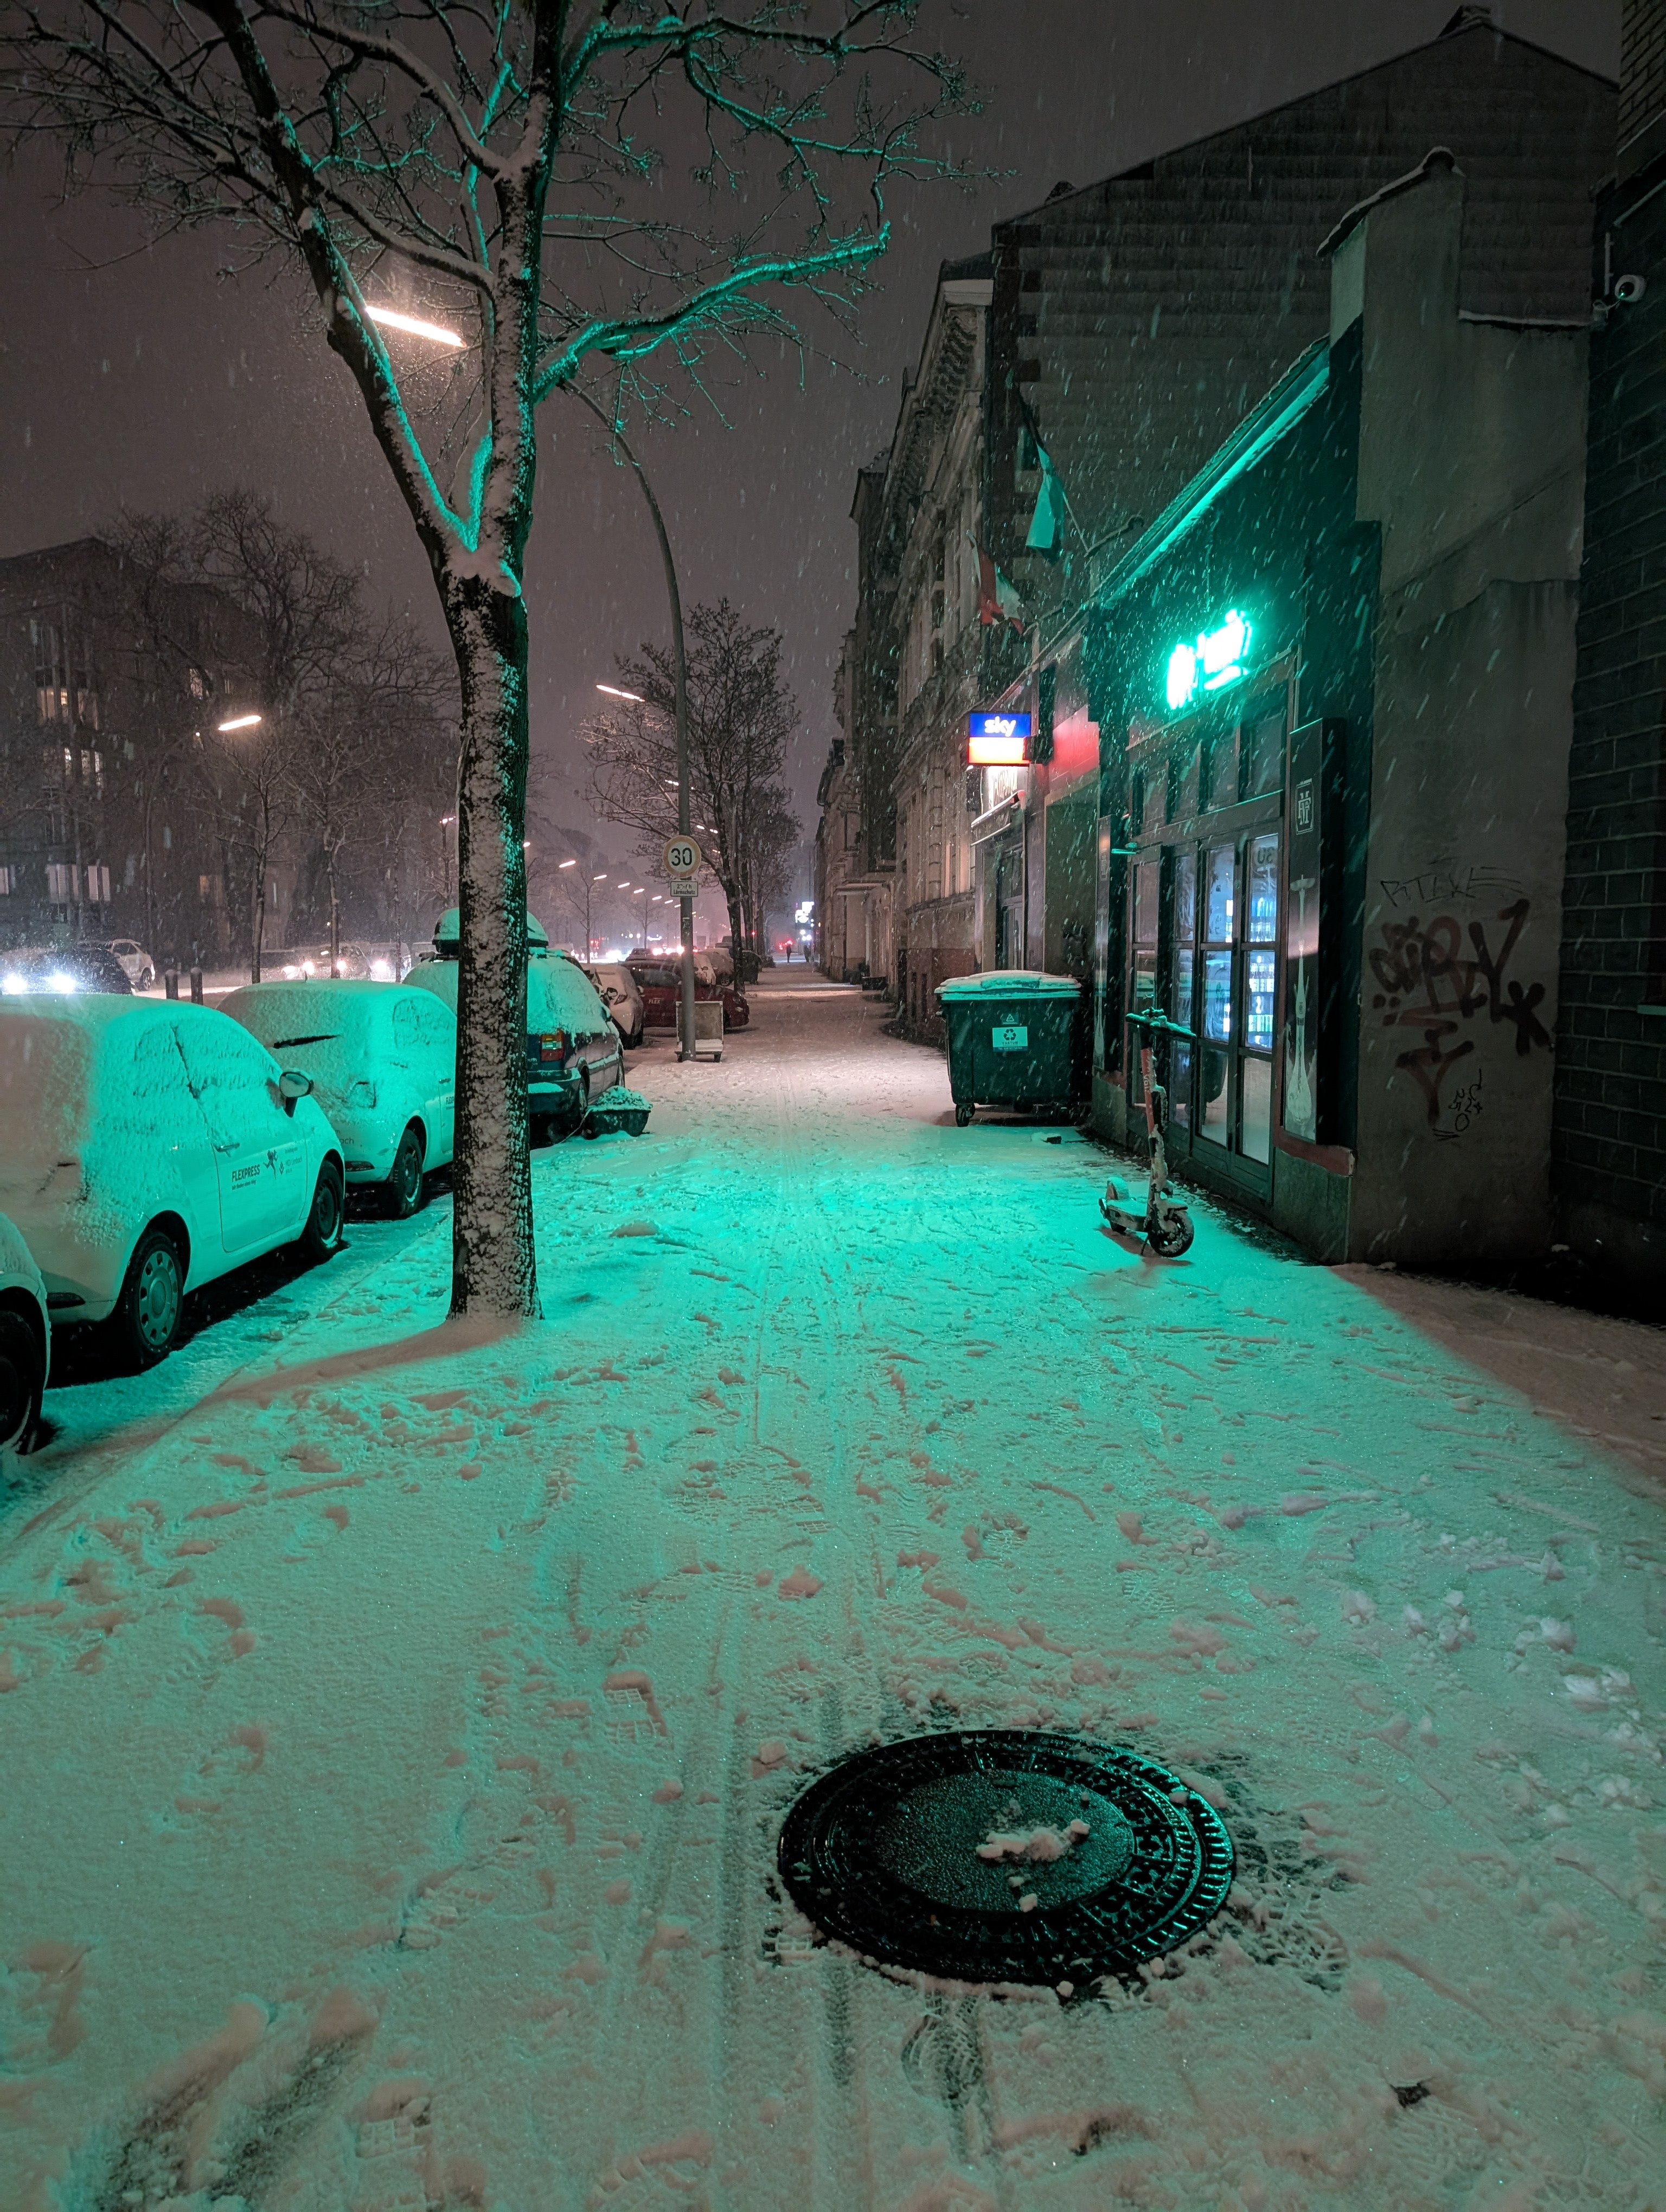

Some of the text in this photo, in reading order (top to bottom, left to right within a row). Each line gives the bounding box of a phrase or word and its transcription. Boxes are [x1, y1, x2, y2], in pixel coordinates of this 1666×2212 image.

[984, 716, 1016, 737] sky
[671, 847, 693, 866] 30
[232, 1164, 260, 1182] FLEXPRESS
